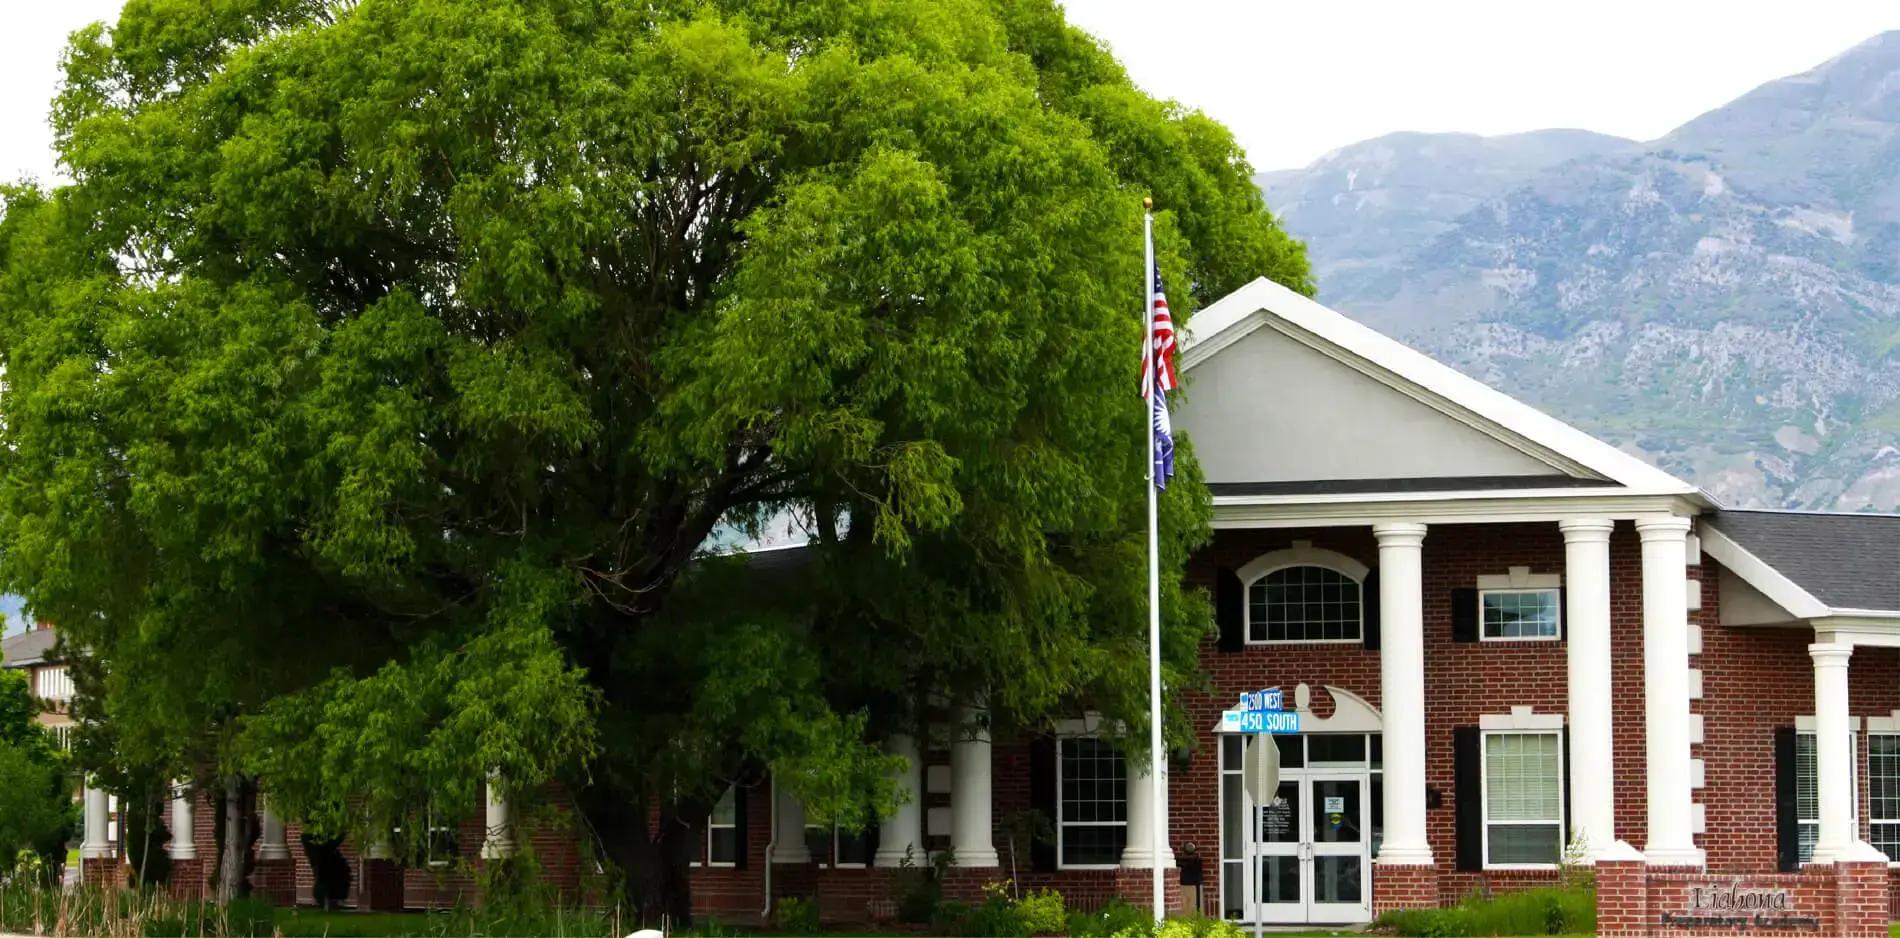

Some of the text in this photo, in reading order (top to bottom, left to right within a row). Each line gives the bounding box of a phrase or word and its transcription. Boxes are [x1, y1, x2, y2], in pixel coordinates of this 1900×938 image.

[1248, 693, 1280, 711] 2500 WEST
[1241, 713, 1263, 730] 450
[1266, 713, 1297, 731] SOUTH
[1692, 881, 1786, 911] Liahona
